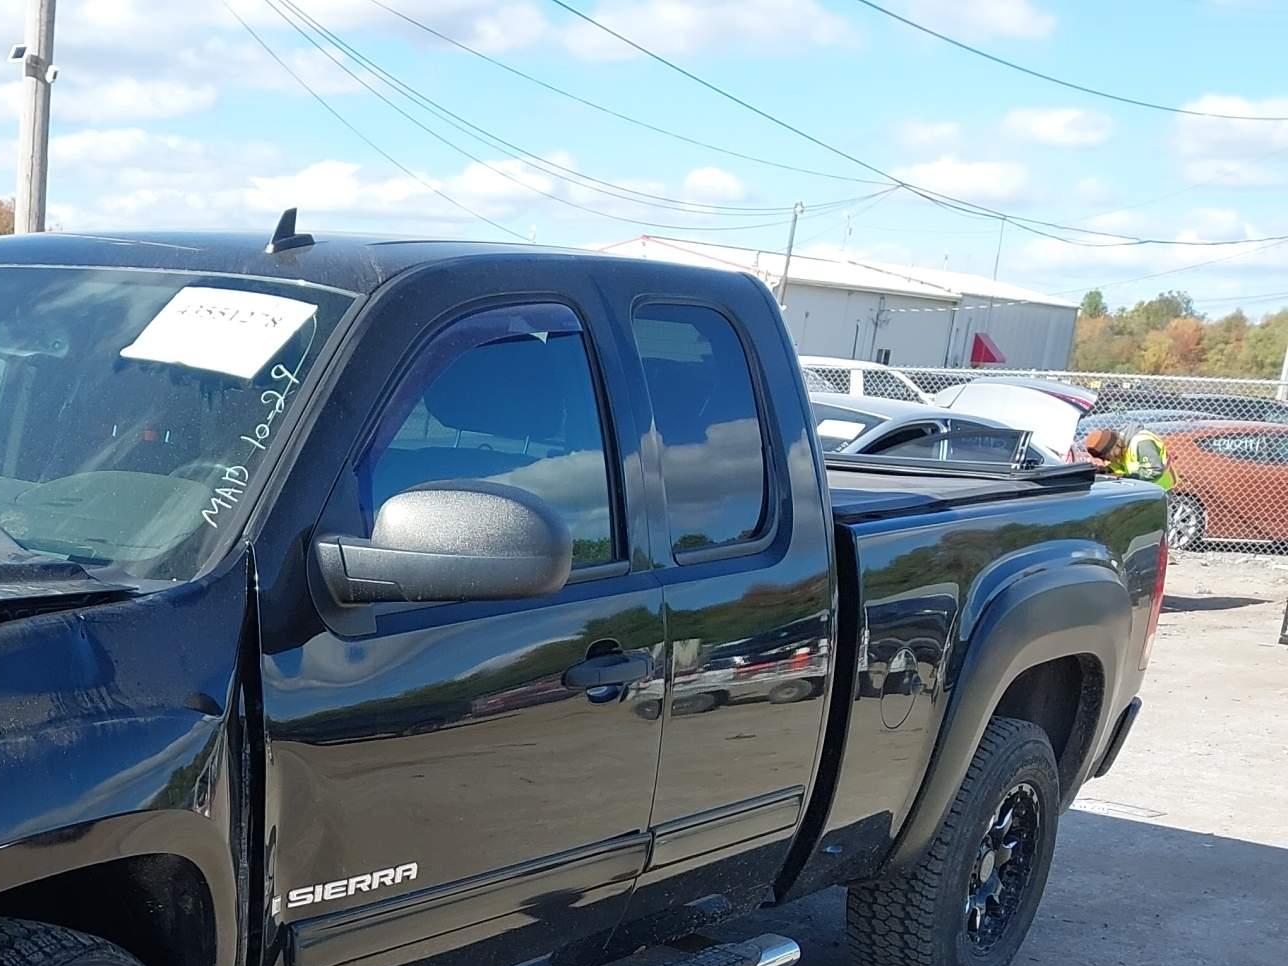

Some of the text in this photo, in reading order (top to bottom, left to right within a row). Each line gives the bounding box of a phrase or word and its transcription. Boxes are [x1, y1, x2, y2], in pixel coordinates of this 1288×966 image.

[201, 363, 300, 528] MAD 10-29
[287, 861, 419, 909] SIERRA
